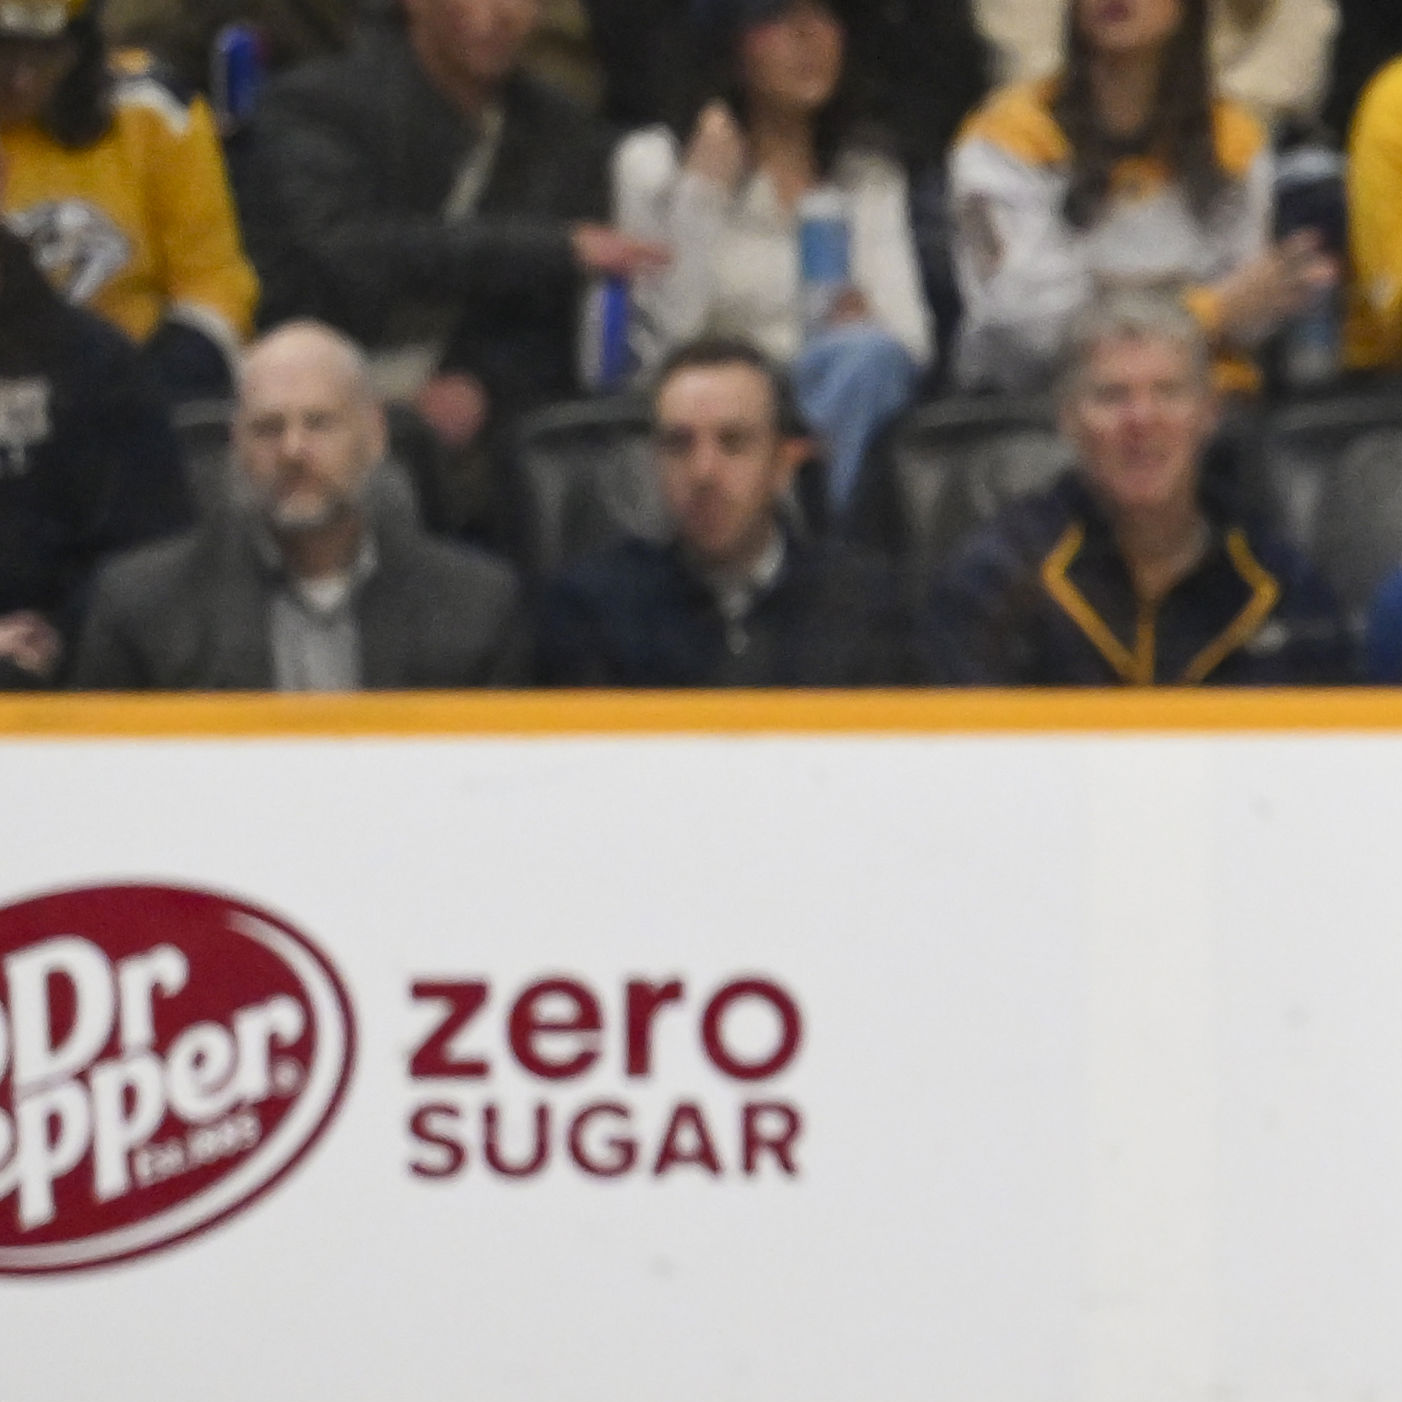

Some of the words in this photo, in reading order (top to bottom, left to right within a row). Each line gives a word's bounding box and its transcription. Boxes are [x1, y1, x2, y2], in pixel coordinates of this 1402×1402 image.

[4, 933, 190, 1088] Dr
[408, 975, 802, 1081] zero
[0, 992, 306, 1233] pper
[406, 1102, 801, 1178] SUGAR
